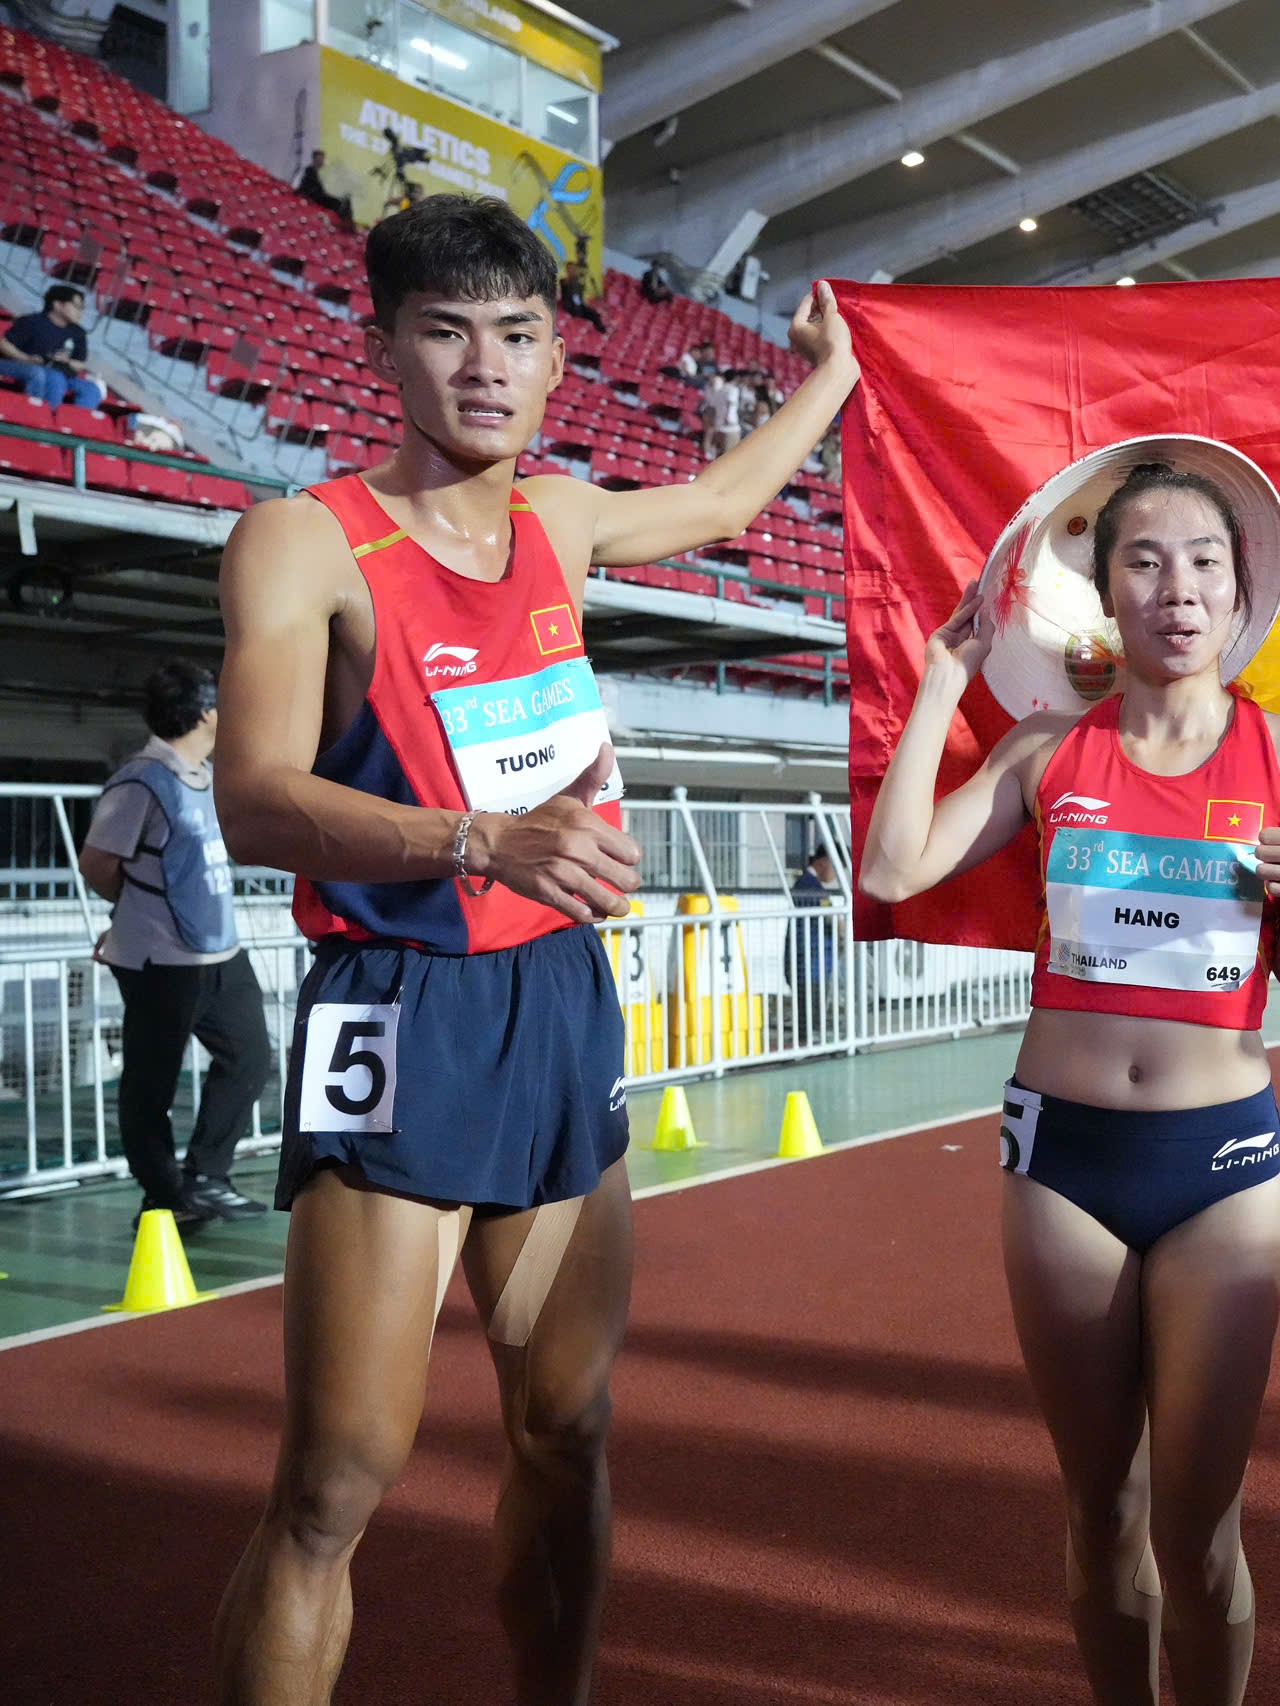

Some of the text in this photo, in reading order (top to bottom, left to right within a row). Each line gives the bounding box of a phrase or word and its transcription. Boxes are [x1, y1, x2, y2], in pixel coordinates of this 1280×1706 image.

[361, 99, 491, 175] ATHLETICS
[425, 661, 477, 677] LI-NING
[483, 696, 527, 727] SEA
[531, 679, 575, 716] GAMES
[496, 744, 556, 775] TUONG
[1050, 813, 1109, 825] LI-NING
[1066, 840, 1240, 885] 33rd SEA GAMES
[1114, 907, 1180, 929] HANG
[1071, 953, 1127, 970] THAILAND
[1206, 966, 1241, 982] 649
[325, 1021, 386, 1115] 5
[1211, 1143, 1280, 1171] LI-NING
